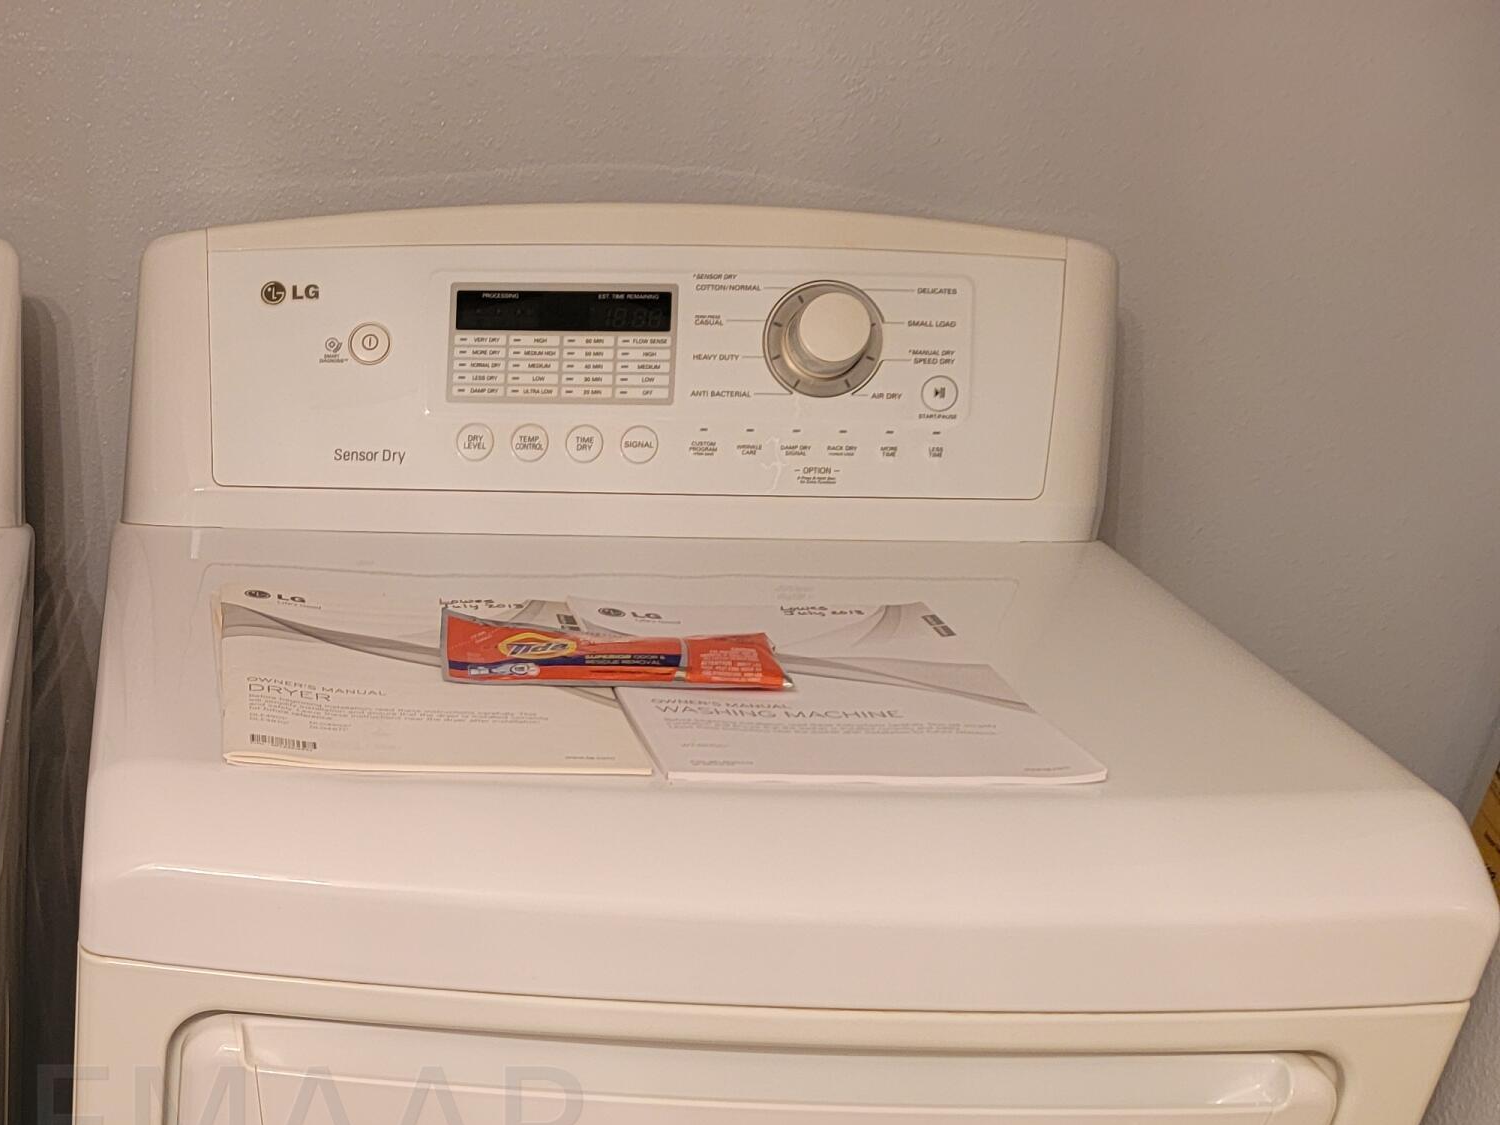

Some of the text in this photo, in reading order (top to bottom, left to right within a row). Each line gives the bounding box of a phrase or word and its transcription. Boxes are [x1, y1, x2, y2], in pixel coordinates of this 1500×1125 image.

[292, 284, 320, 300] LG
[917, 287, 958, 295] DELICATES
[907, 320, 957, 328] SMALL LOAD
[690, 390, 752, 398] ANTI BACTERIAL
[467, 434, 484, 442] DRY
[575, 436, 595, 444] TIME
[463, 442, 487, 450] LEVEL
[515, 443, 544, 451] CONTROL
[576, 443, 593, 452] DRY
[624, 440, 654, 449] SIGNAL
[333, 448, 406, 465] Sensor Dry
[803, 466, 832, 475] OPTION
[277, 593, 306, 603] LG
[631, 611, 662, 620] LG
[246, 676, 388, 696] OWNER'S MANUAL
[248, 683, 331, 702] DRYER
[655, 705, 904, 719] WASHING MACHINE
